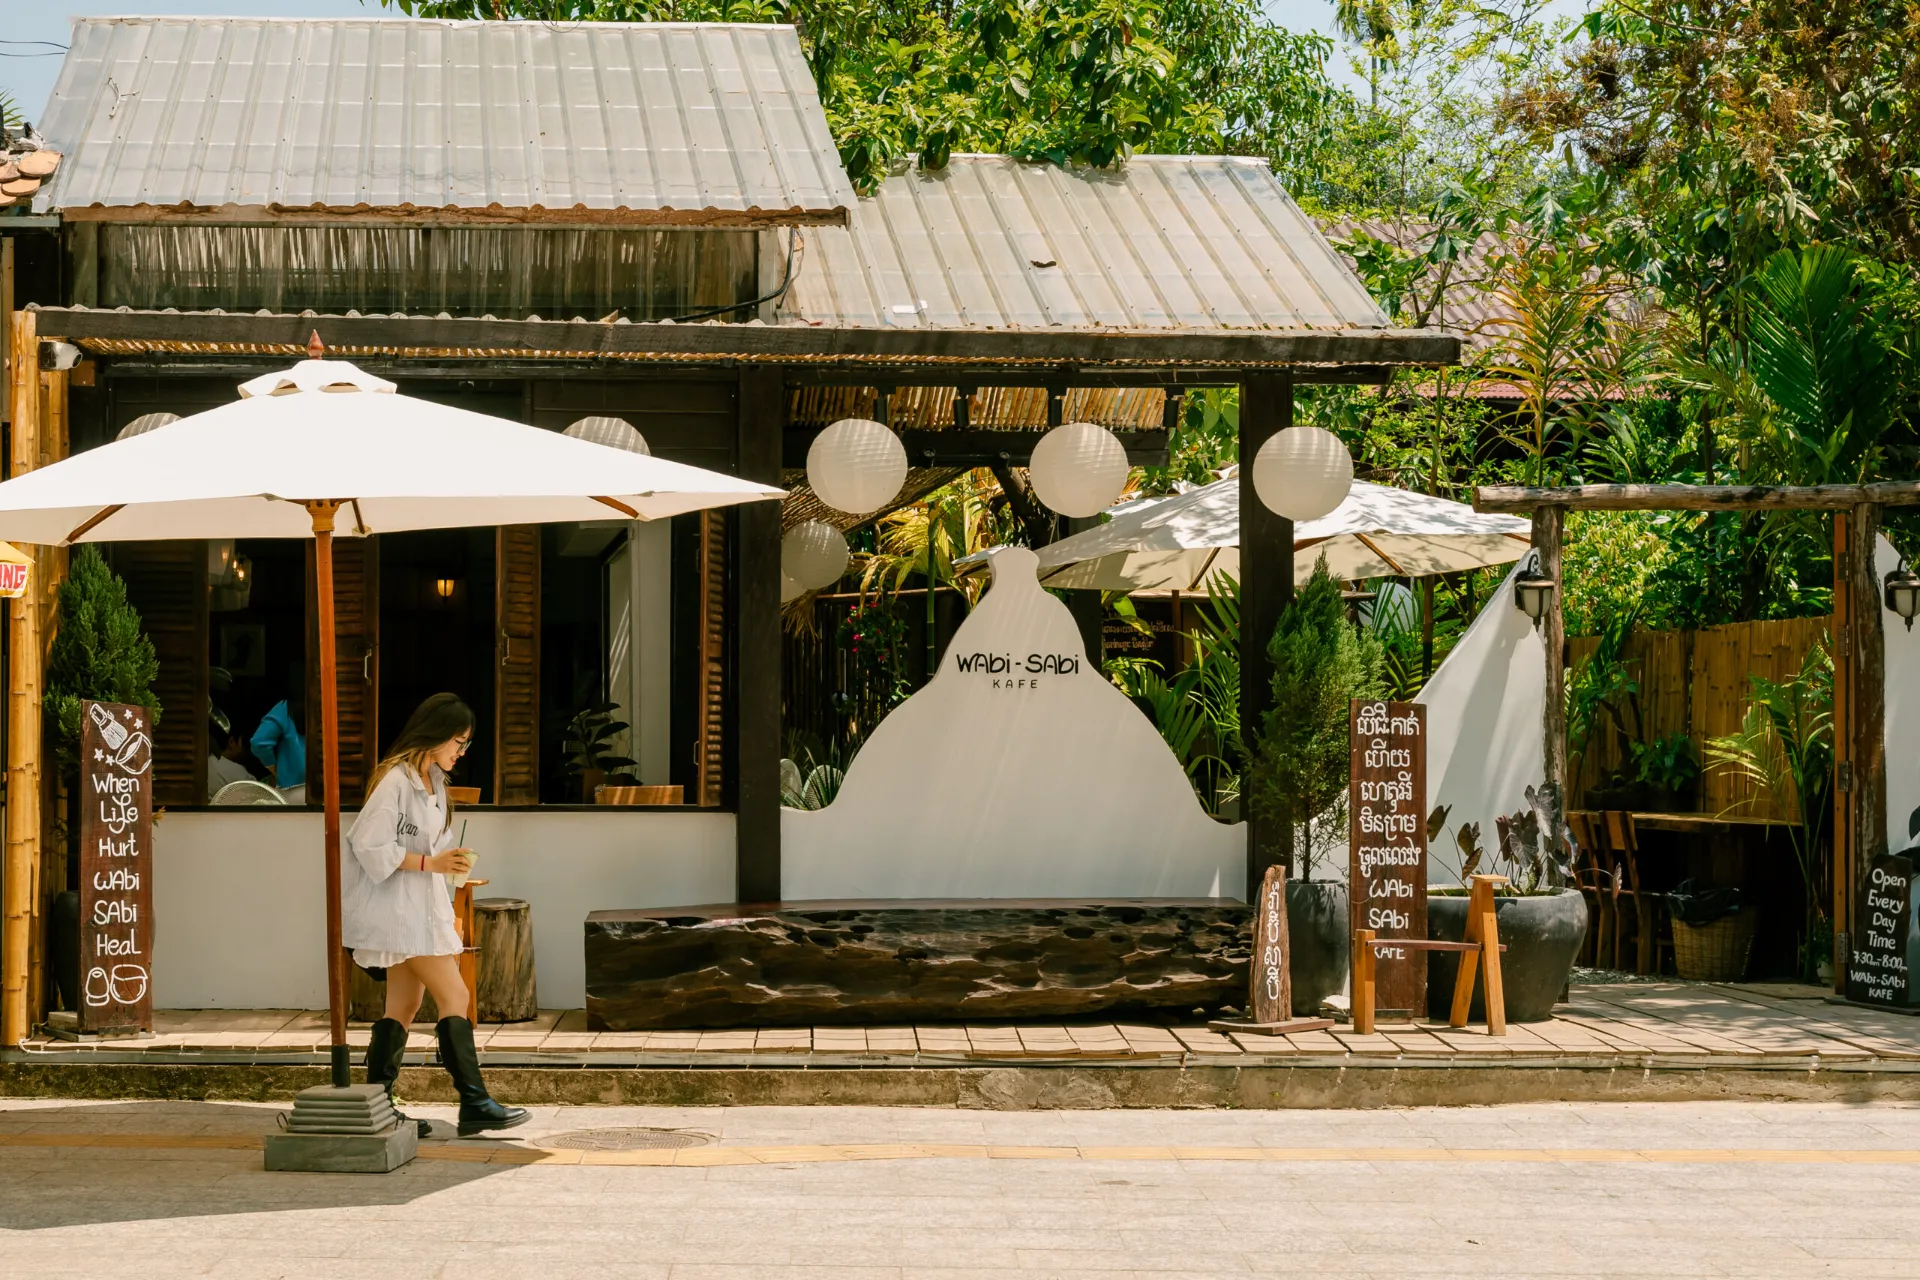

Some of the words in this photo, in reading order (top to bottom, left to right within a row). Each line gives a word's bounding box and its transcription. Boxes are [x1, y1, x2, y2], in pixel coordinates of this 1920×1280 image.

[992, 679, 1038, 689] KAFE
[1364, 738, 1410, 768] ហើយ
[92, 773, 140, 794] When
[100, 794, 139, 834] Life
[98, 833, 139, 858] Hurt
[1871, 868, 1907, 892] Open
[1867, 889, 1904, 914] Every
[1872, 911, 1897, 934] Day
[1867, 930, 1896, 950] Time
[1868, 987, 1894, 1000] KAFE
